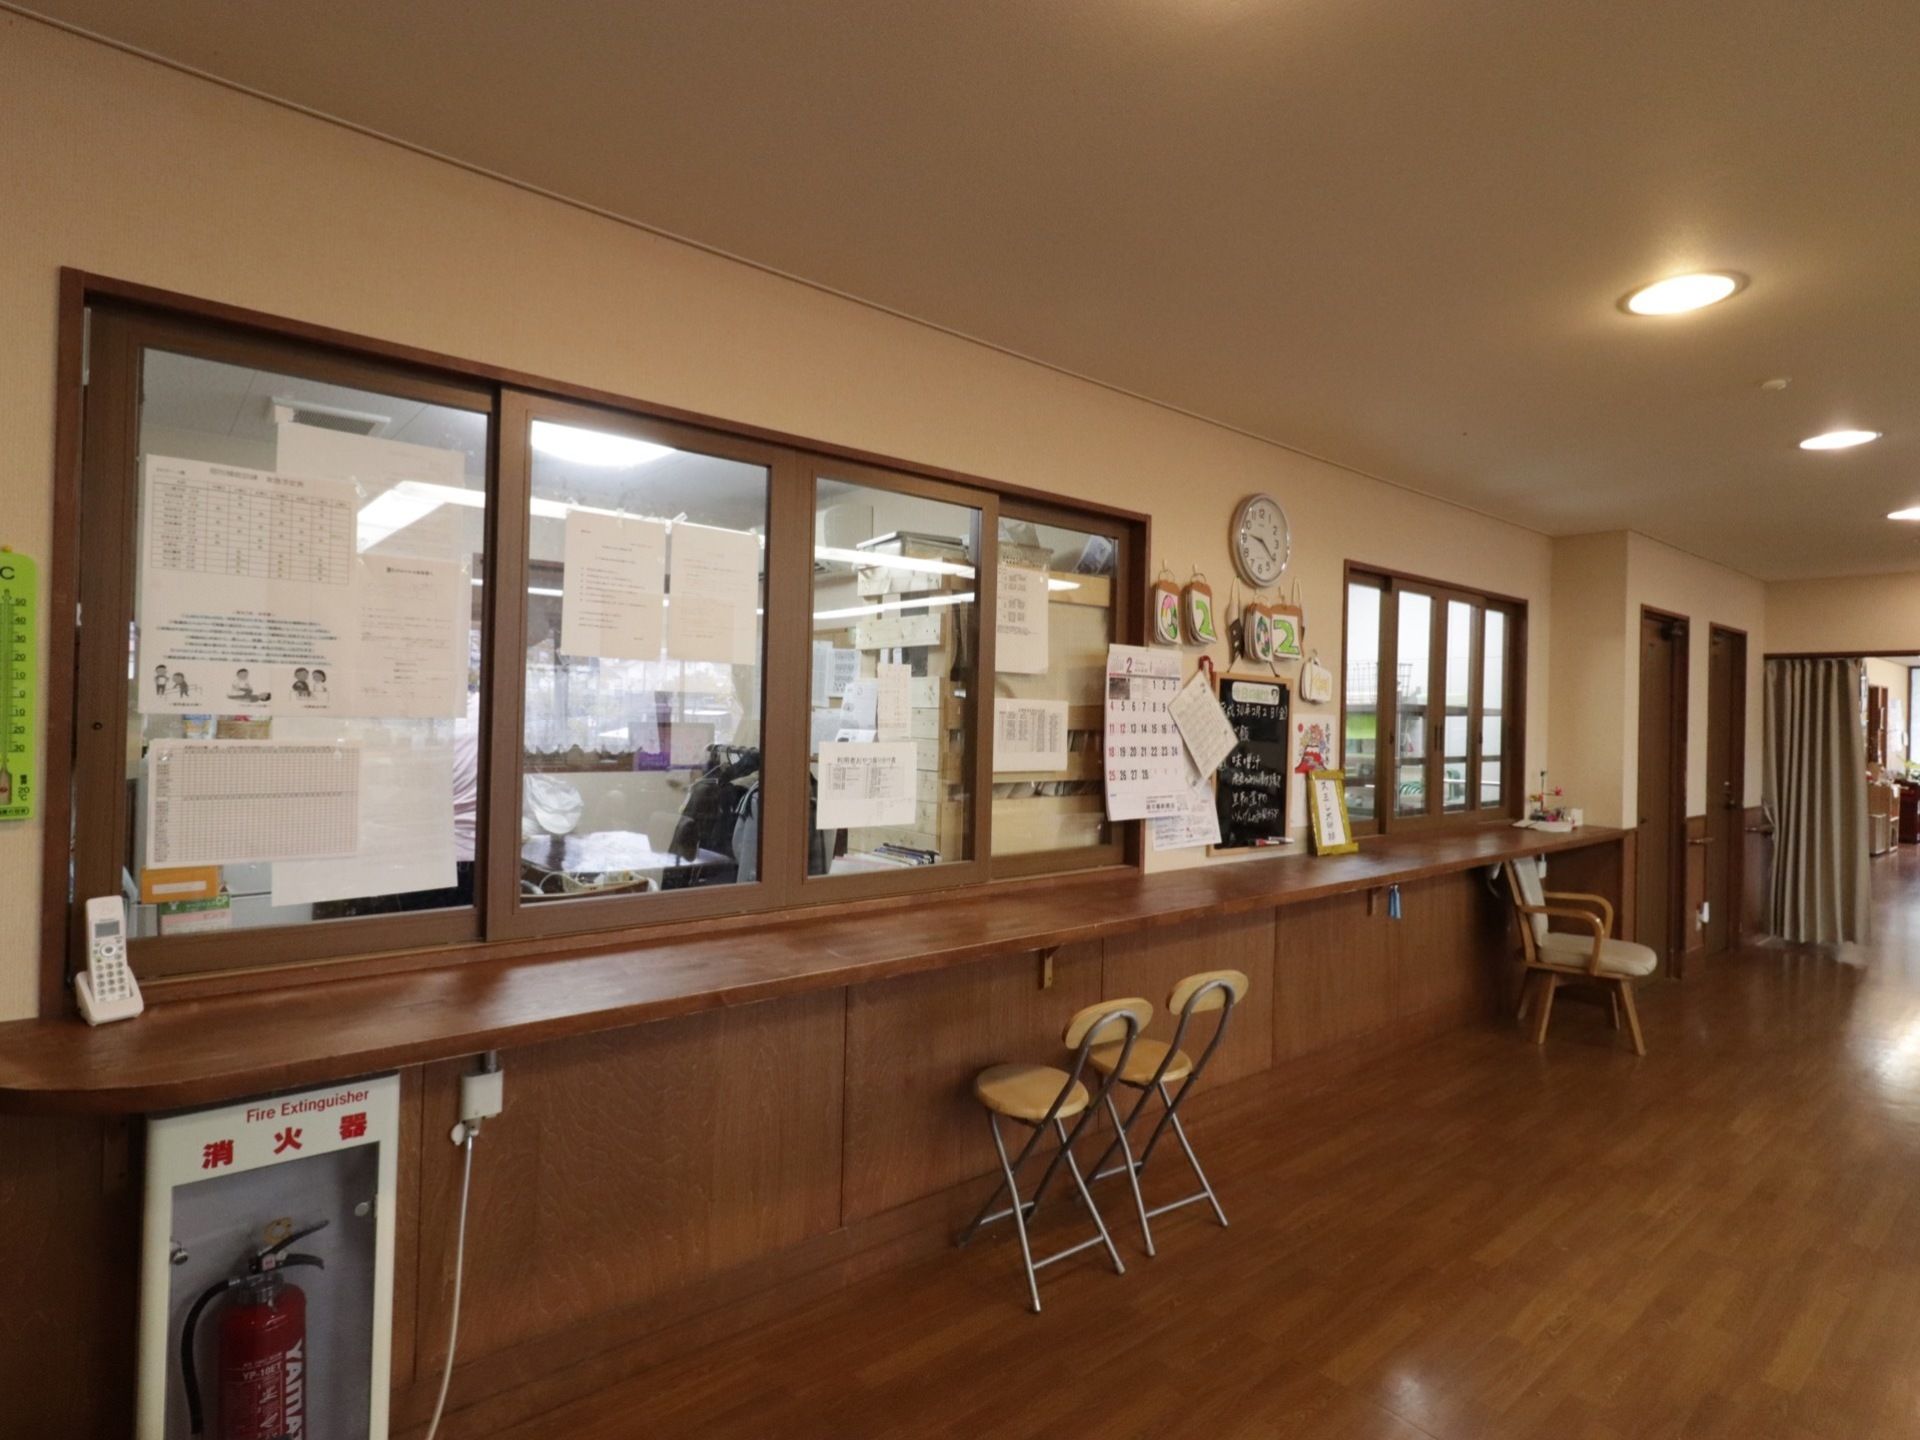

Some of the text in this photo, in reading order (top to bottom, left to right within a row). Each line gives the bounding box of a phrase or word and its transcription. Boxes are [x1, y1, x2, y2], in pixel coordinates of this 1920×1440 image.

[15, 598, 26, 606] 50
[15, 616, 26, 624] 40
[1195, 600, 1214, 638] 2
[15, 634, 26, 642] 30
[1273, 620, 1300, 655] 2
[15, 653, 26, 661] 20
[1126, 657, 1133, 674] 2
[1153, 680, 1176, 691] 1 2 3
[1121, 701, 1125, 711] 5
[1132, 702, 1136, 712] 6
[1142, 702, 1146, 712] 7
[1152, 702, 1156, 712] 8
[1162, 703, 1166, 712] 9
[14, 726, 25, 734] 20
[1109, 724, 1115, 734] 11
[1120, 724, 1126, 734] 12
[1130, 724, 1136, 734] 13
[1141, 724, 1147, 734] 14
[1151, 724, 1157, 734] 15
[1161, 724, 1167, 734] 16
[14, 744, 25, 752] 30
[1109, 747, 1178, 757] 18 19 20 21 22 23 24
[1109, 770, 1115, 781] 25
[1120, 770, 1126, 780] 26
[1131, 770, 1138, 780] 27
[1142, 769, 1148, 780] 28
[246, 1090, 369, 1123] Fire Extinguisher
[202, 1112, 367, 1169] 消火器
